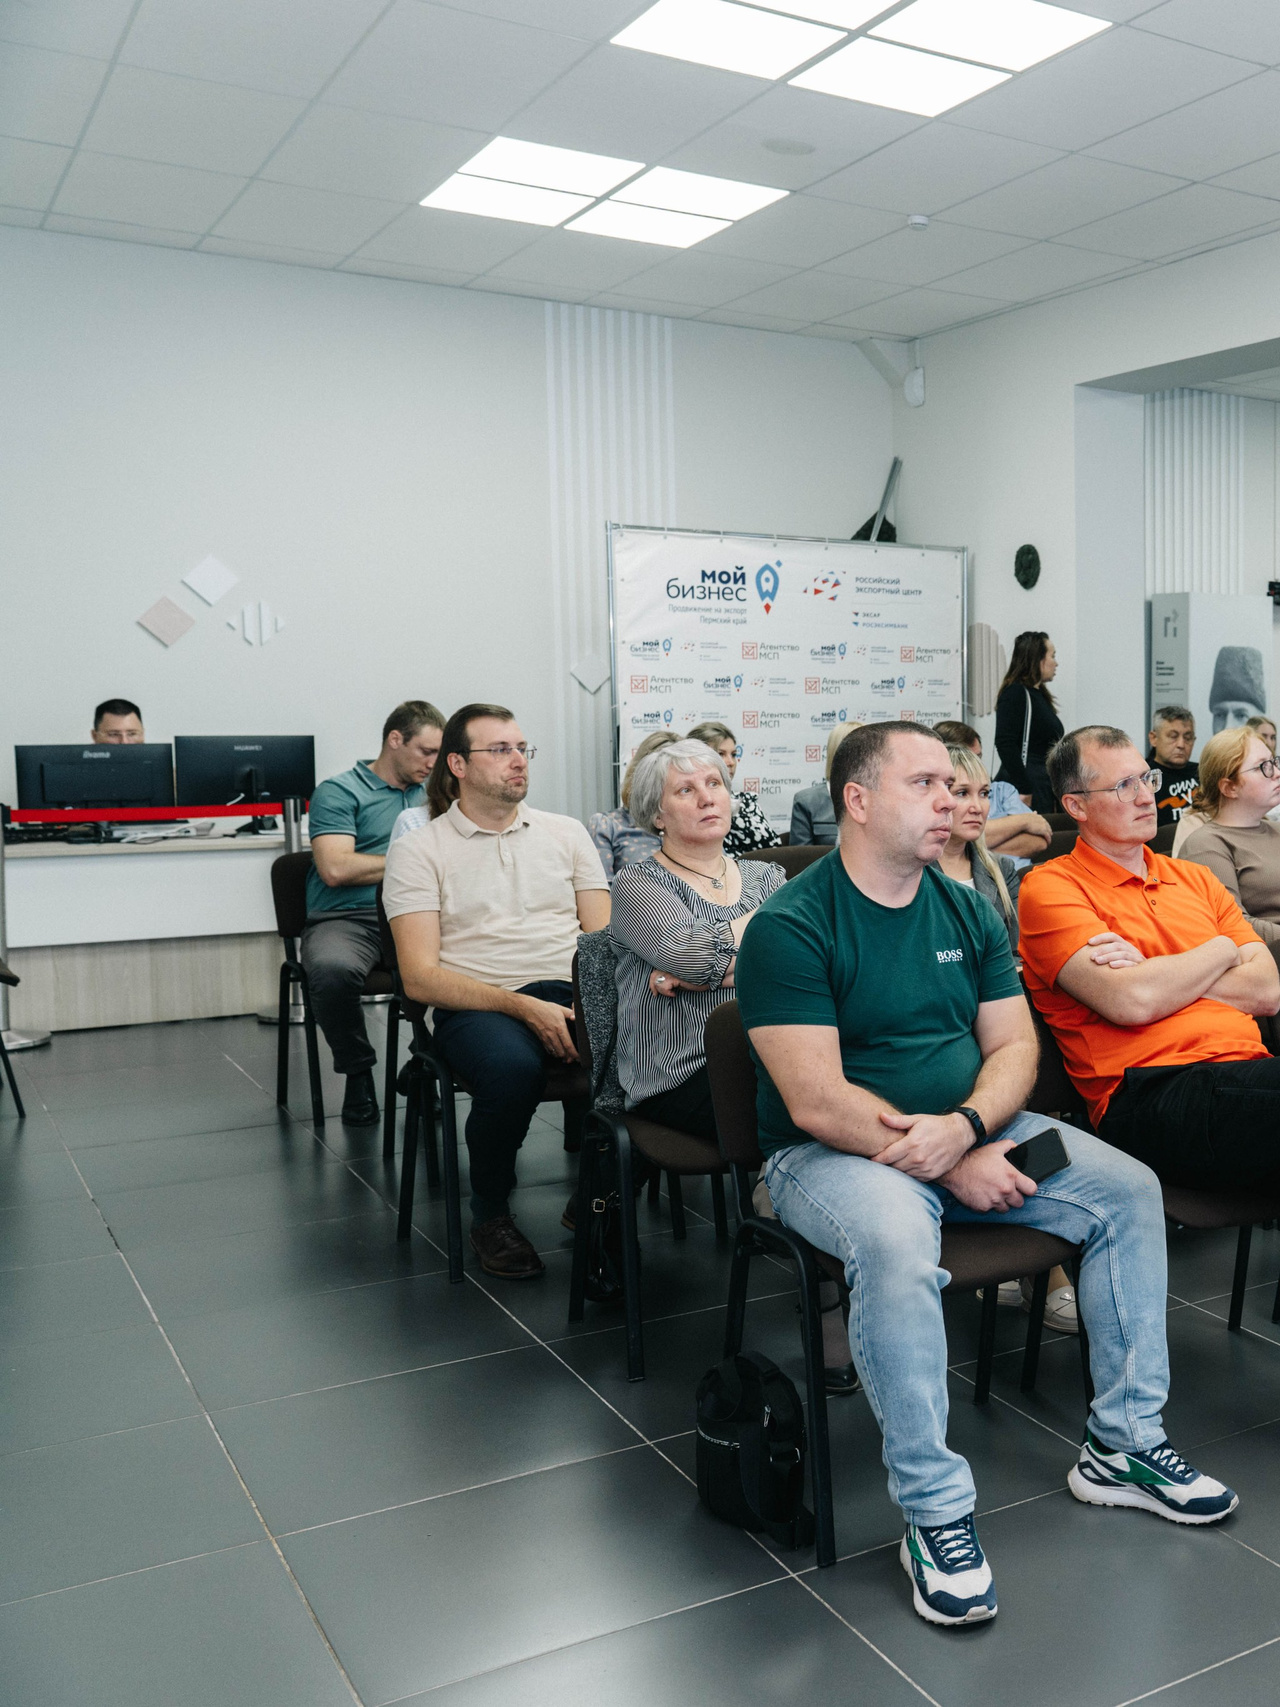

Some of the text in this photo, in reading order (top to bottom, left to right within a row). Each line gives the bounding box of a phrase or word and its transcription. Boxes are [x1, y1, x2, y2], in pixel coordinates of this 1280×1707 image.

[701, 566, 745, 585] мой
[667, 577, 747, 601] бизнес
[669, 604, 712, 614] Продвижение
[700, 616, 747, 625] Пермский край
[760, 643, 800, 651] Агентство
[916, 647, 951, 655] Агентство
[760, 652, 779, 660] МСП
[650, 676, 693, 684] Агентство
[822, 678, 860, 686] Агентство
[650, 685, 671, 693] МСП
[760, 711, 800, 719] Агентство
[916, 710, 951, 718] Агентство
[760, 720, 780, 728] МСП
[762, 777, 801, 785] Агентство
[761, 787, 781, 795] МСП
[936, 949, 963, 960] BOSS
